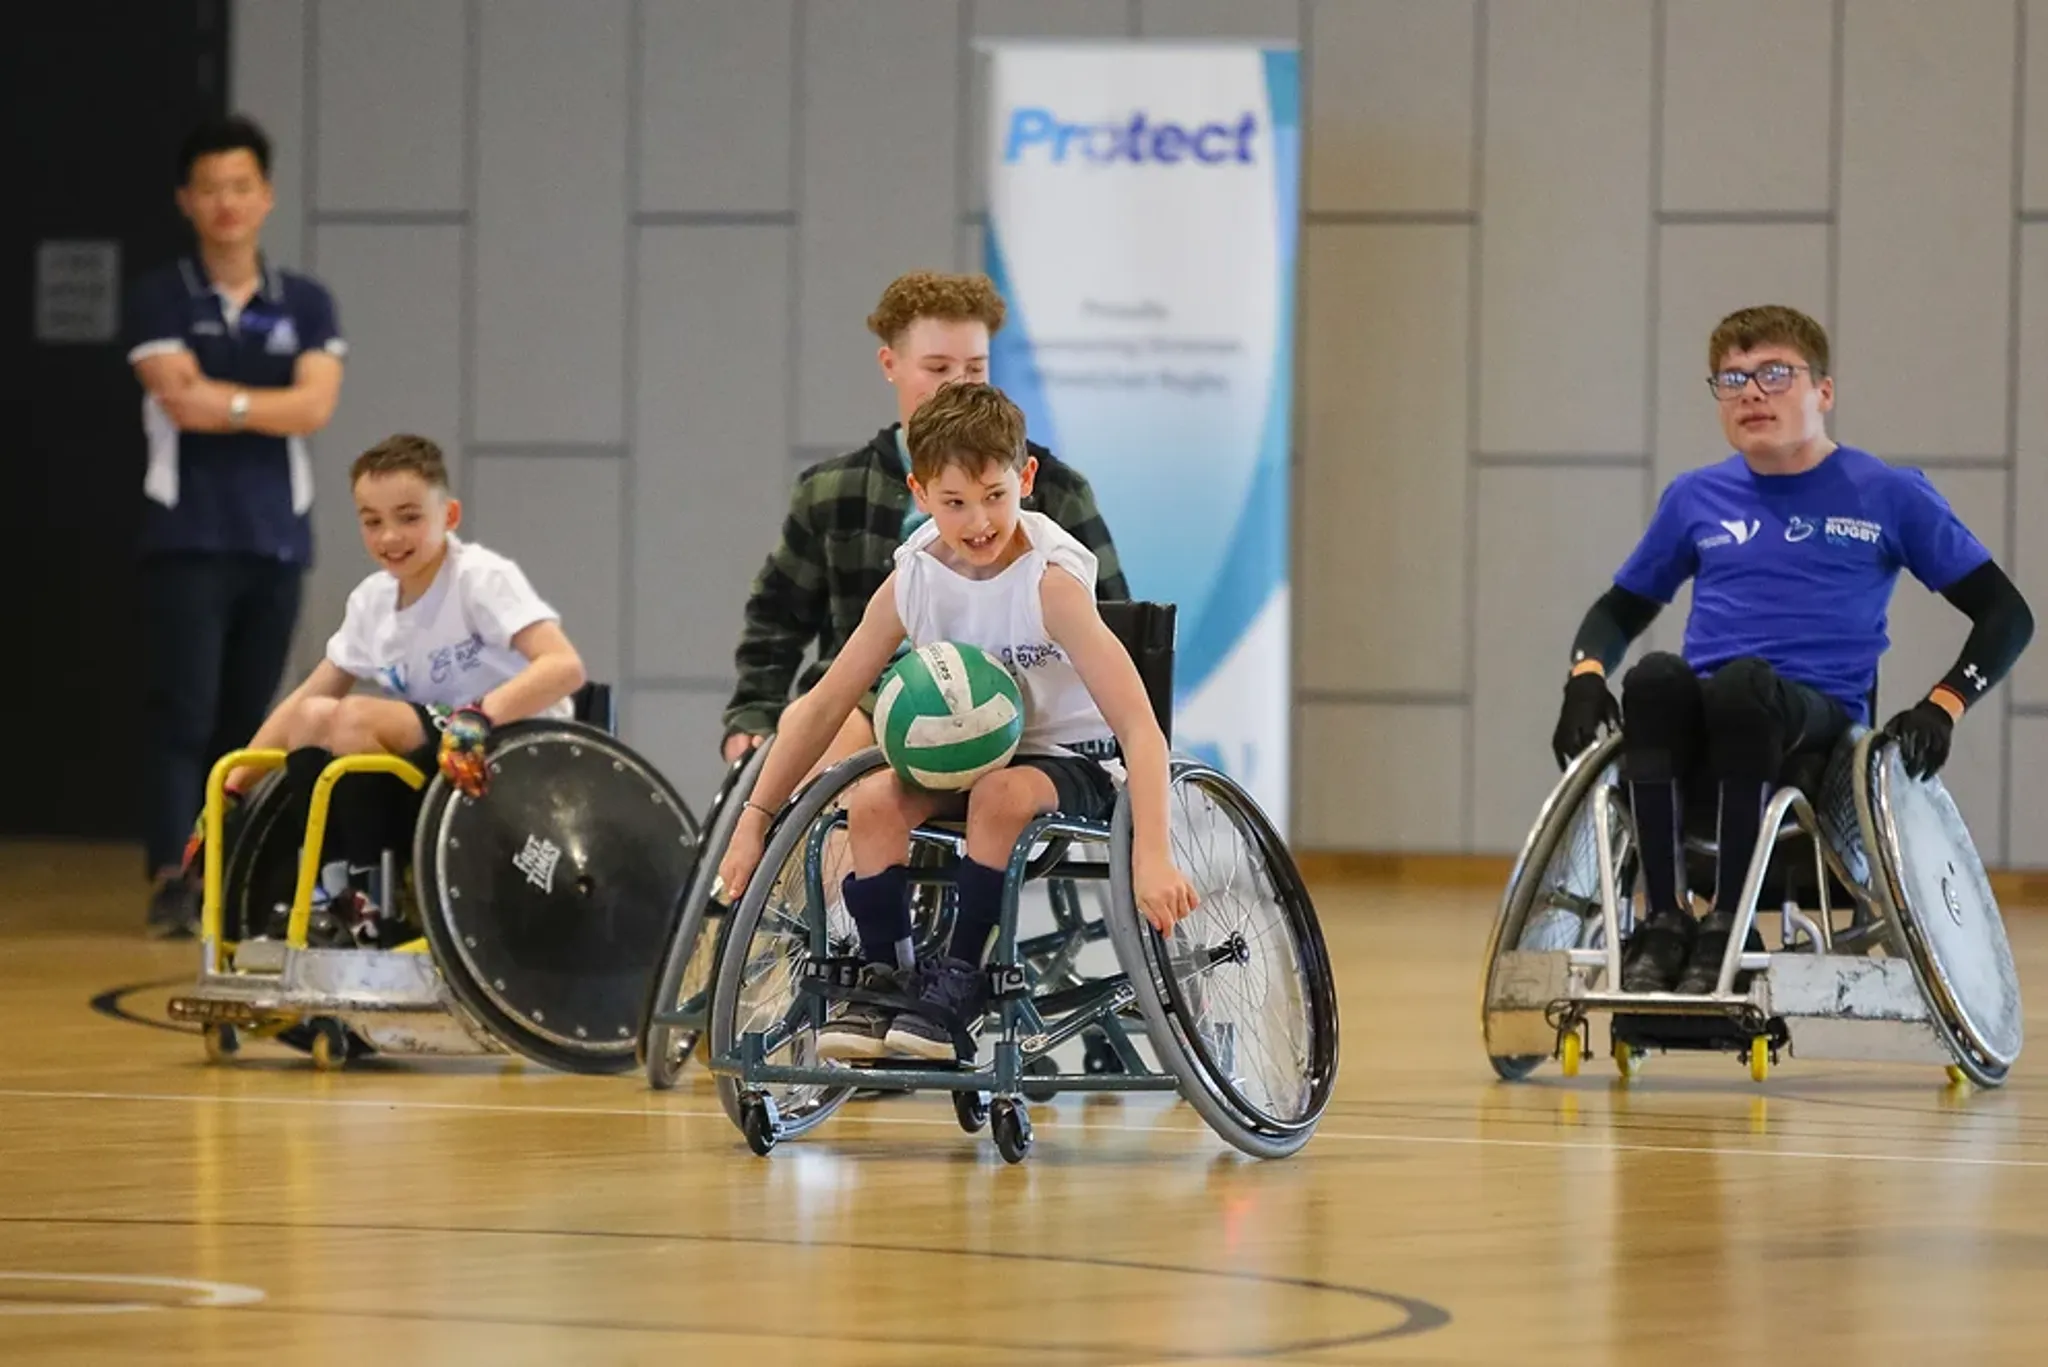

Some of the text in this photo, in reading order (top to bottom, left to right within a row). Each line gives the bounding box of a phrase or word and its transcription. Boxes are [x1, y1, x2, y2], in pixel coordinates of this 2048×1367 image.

[1003, 107, 1258, 164] Protect
[1825, 521, 1880, 544] RUGBY
[512, 833, 542, 874] FAST
[527, 837, 560, 890] TIMES
